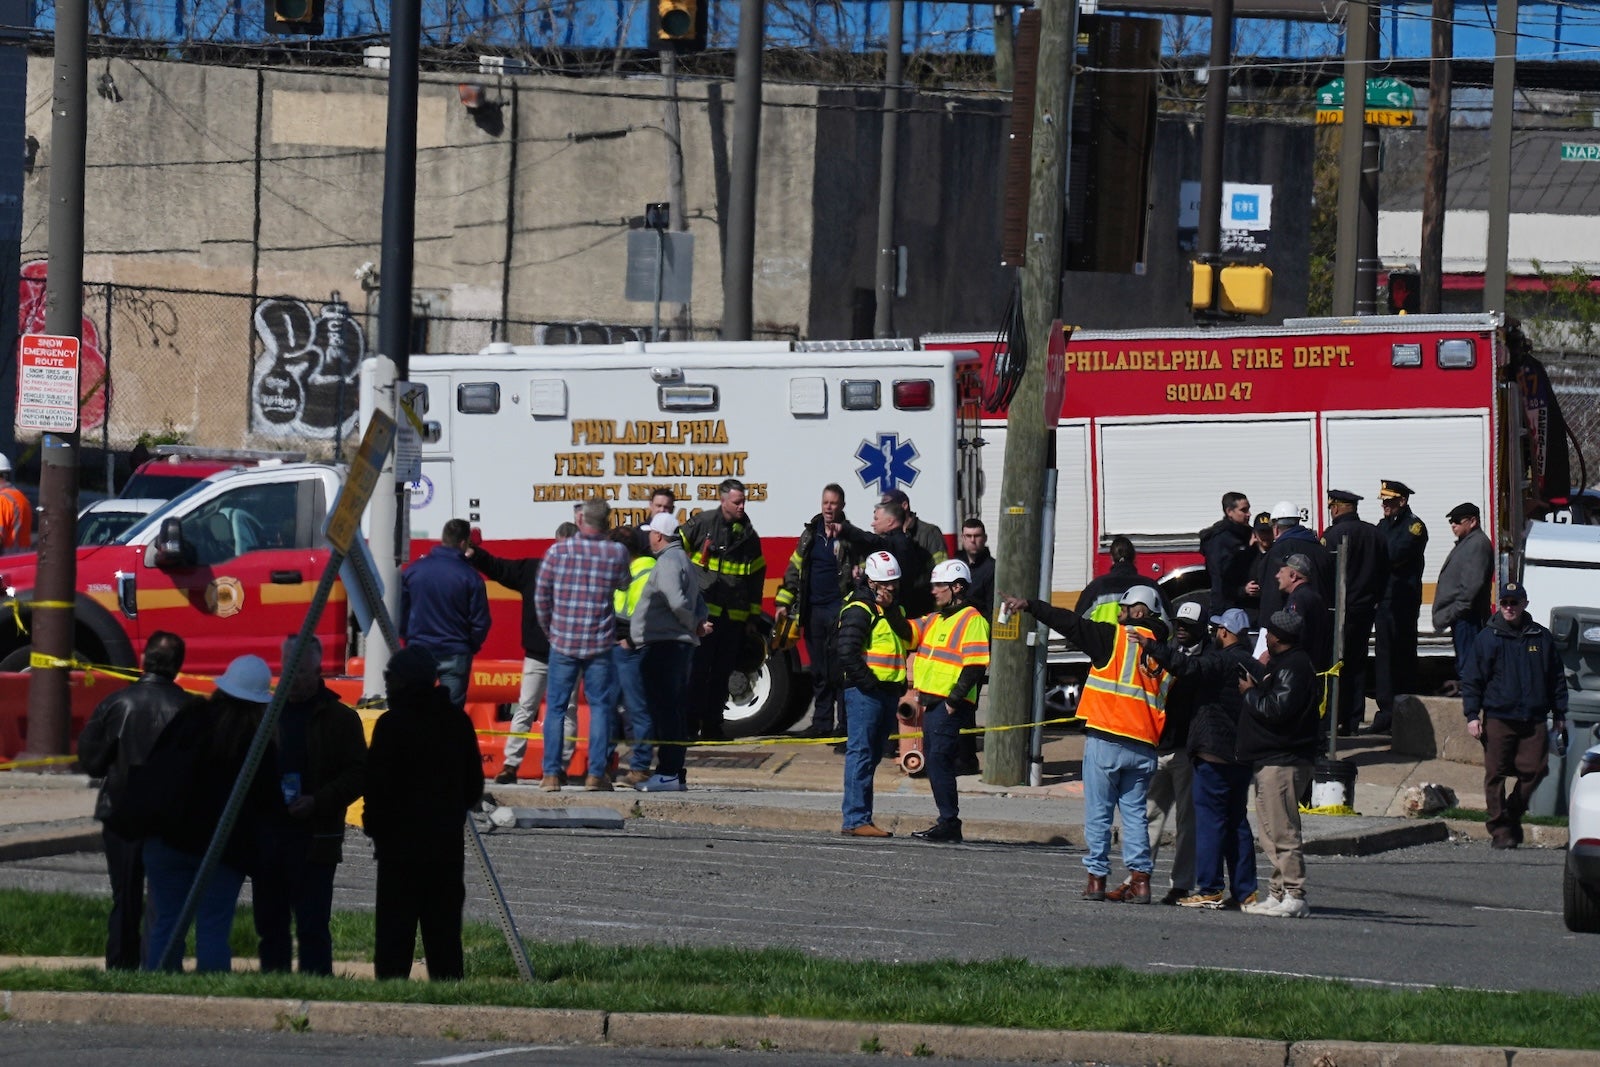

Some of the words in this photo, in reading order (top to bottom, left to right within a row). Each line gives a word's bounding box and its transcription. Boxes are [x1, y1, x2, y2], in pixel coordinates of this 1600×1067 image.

[1320, 112, 1339, 123] NO
[37, 339, 63, 347] SNOW
[24, 347, 76, 358] EMERGENCY
[1065, 350, 1222, 373] PHILADELPHIA
[1232, 348, 1283, 369] FIRE
[1293, 345, 1355, 368] DEPT.
[34, 358, 64, 367] ROUTE
[1166, 382, 1226, 402] SQUAD
[1229, 382, 1253, 401] 47
[22, 414, 73, 422] INFORMATION
[572, 419, 729, 446] PHILADELPHIA
[554, 451, 604, 477] FIRE
[614, 451, 749, 477] DEPARTMENT
[533, 484, 622, 502] EMERGENCY
